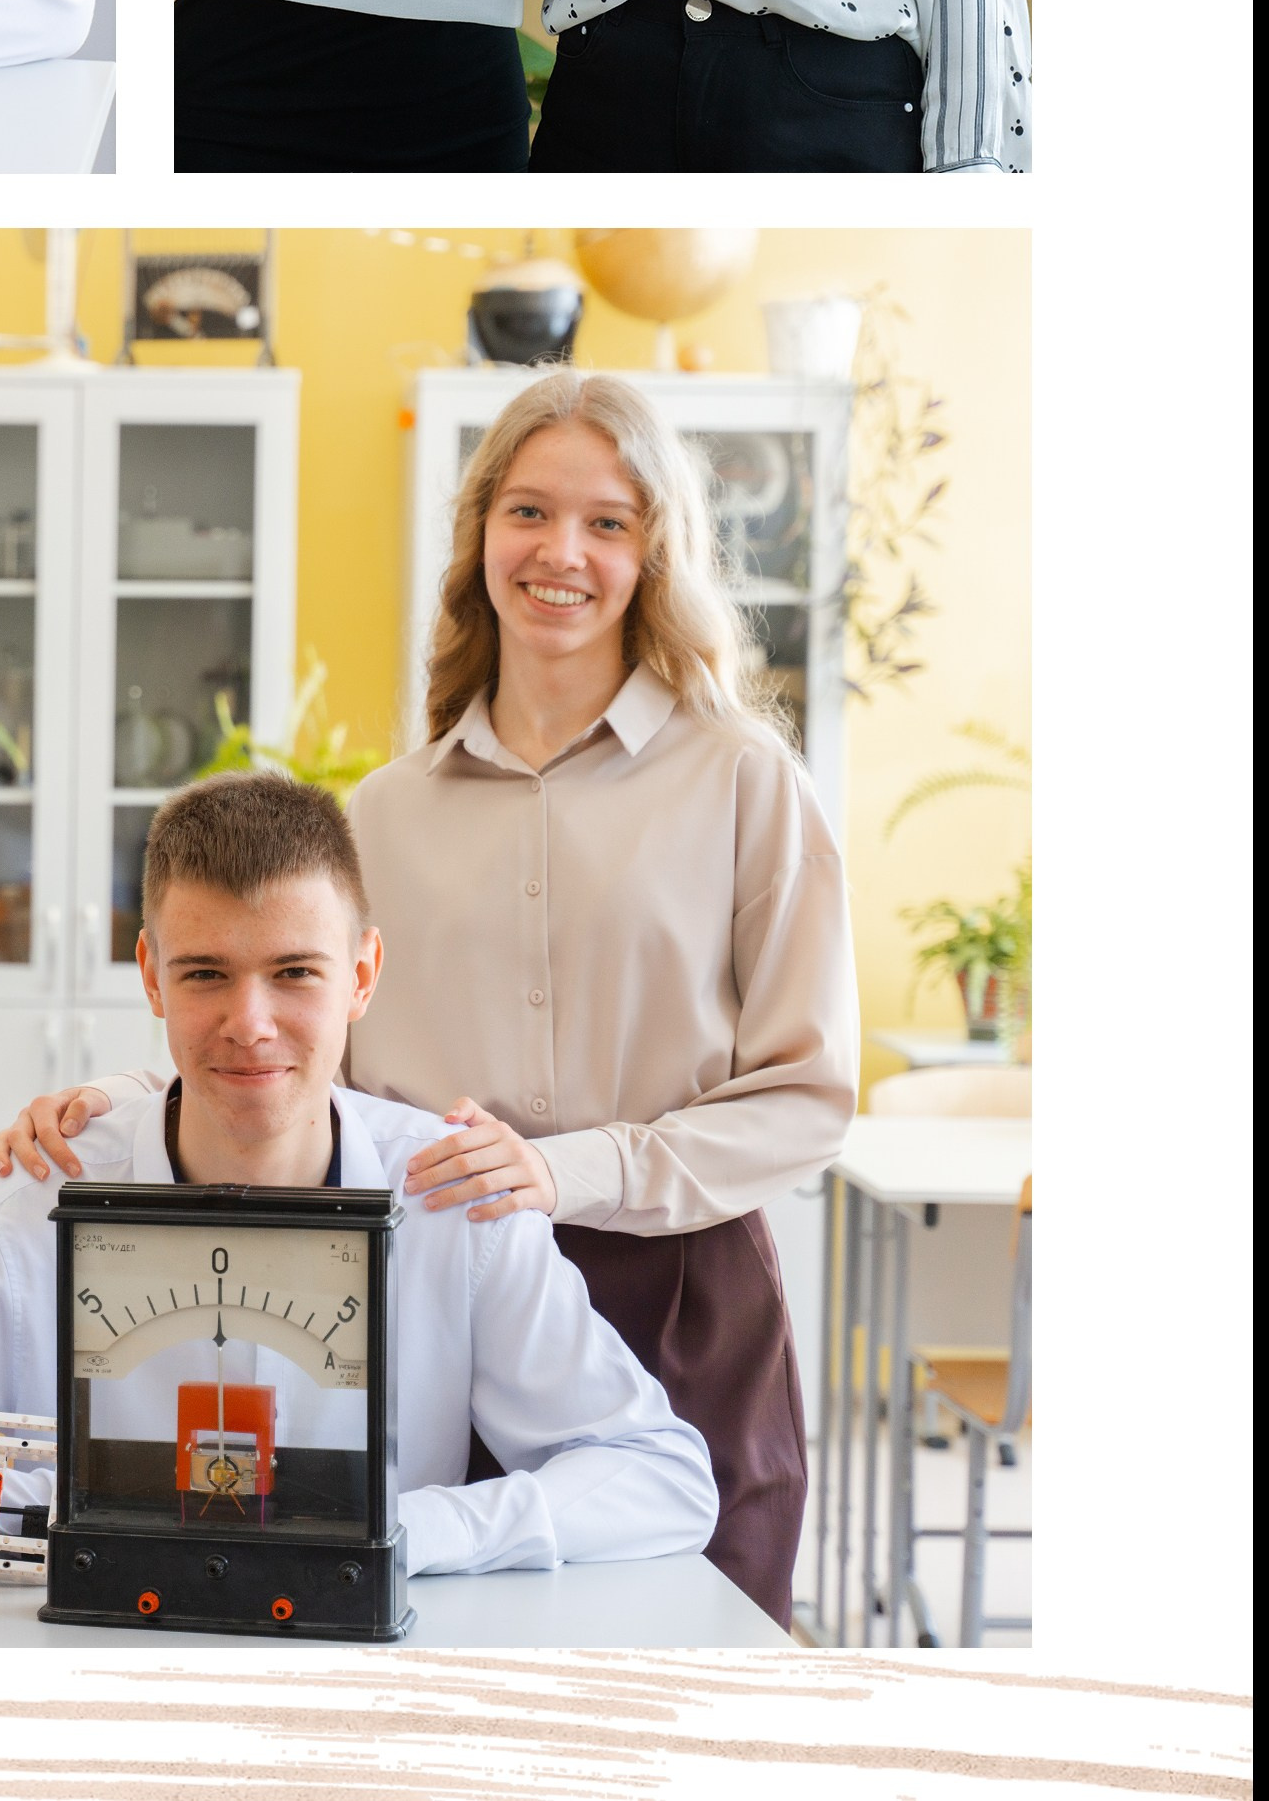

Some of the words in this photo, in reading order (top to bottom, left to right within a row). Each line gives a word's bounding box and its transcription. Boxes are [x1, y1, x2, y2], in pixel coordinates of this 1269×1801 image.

[211, 1247, 229, 1274] 0
[77, 1287, 103, 1315] 5
[337, 1295, 361, 1323] 5
[324, 1351, 336, 1370] A
